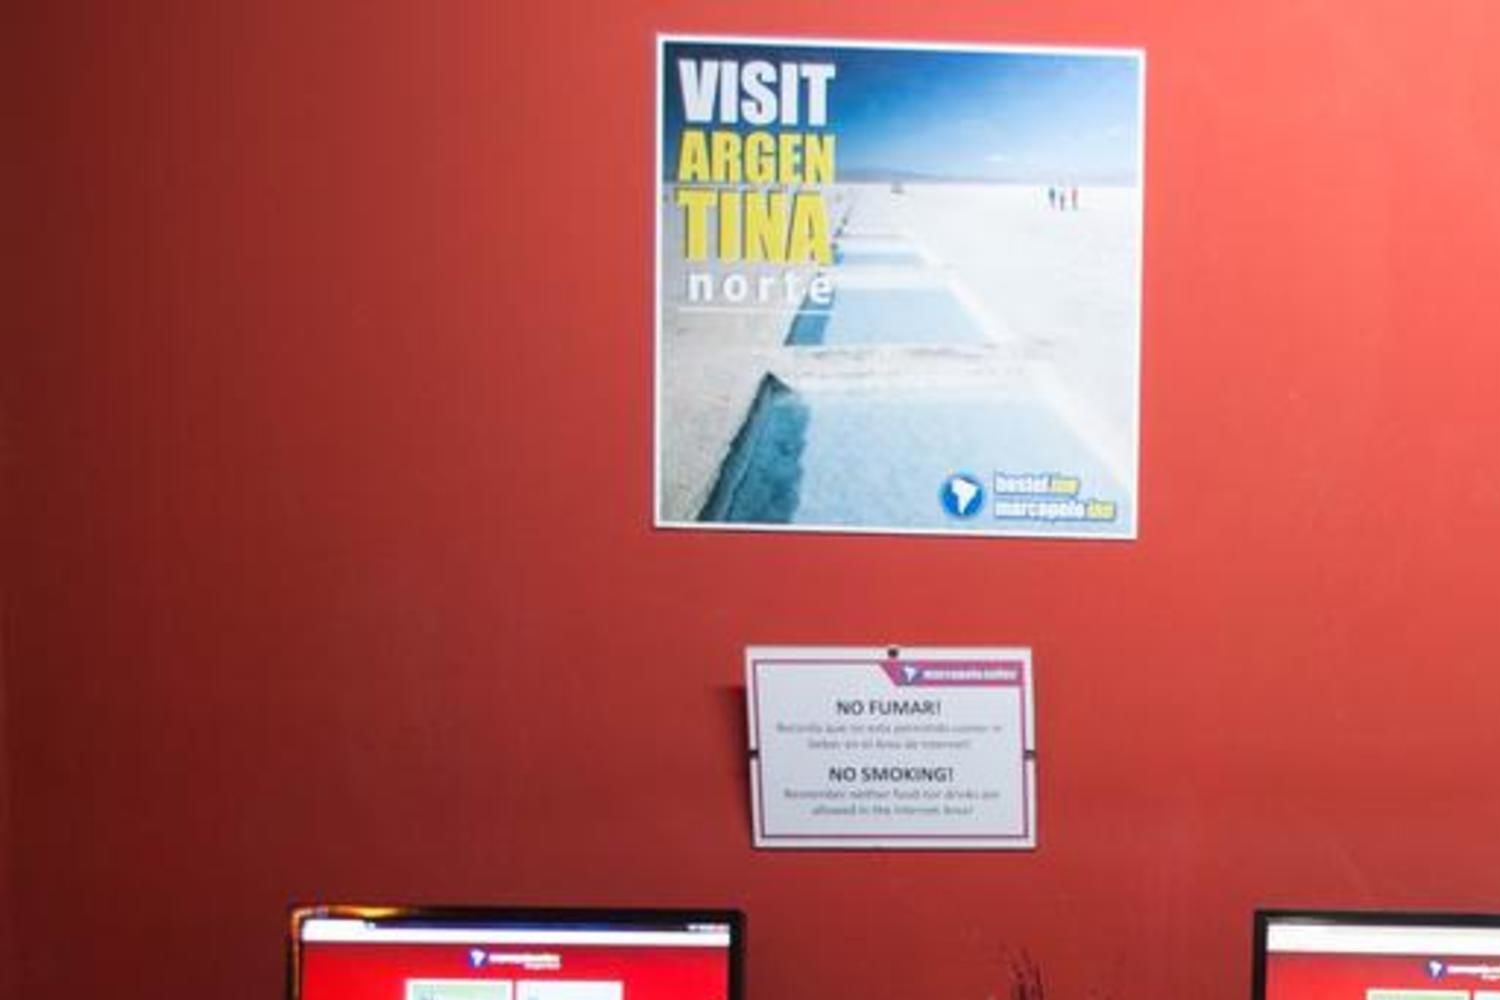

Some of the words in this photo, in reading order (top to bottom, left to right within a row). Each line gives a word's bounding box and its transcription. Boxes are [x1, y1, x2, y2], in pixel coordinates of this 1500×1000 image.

[678, 58, 836, 127] VISIT
[678, 130, 836, 185] ARGEN
[677, 189, 832, 264] TINA
[688, 270, 834, 303] norte
[836, 700, 864, 715] NO
[869, 700, 941, 715] FUMAR!
[829, 767, 856, 782] NO
[861, 766, 954, 782] SMOKING!
